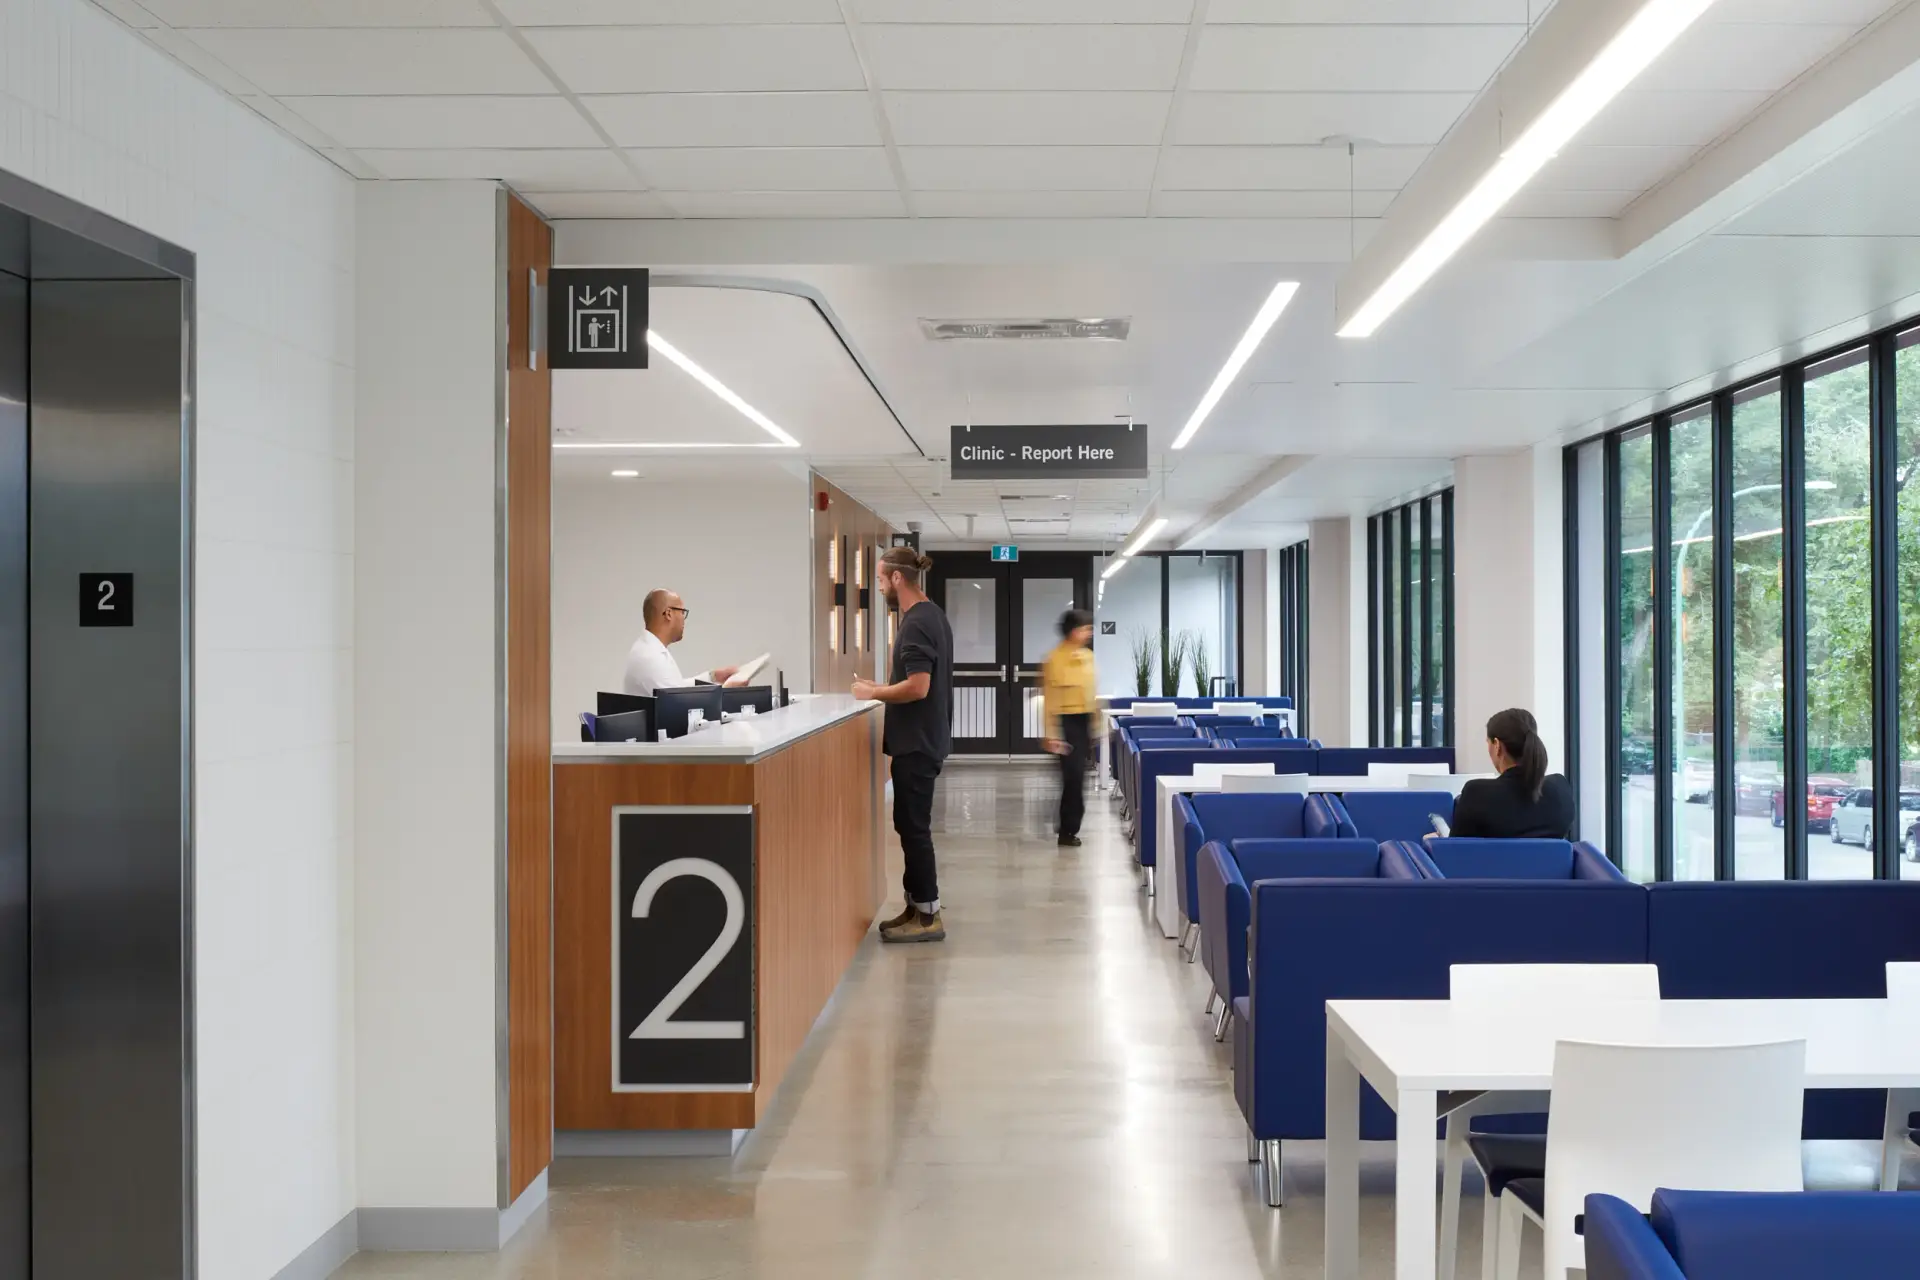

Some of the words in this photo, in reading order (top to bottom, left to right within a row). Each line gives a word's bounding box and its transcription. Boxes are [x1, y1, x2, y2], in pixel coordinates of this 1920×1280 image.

[960, 445, 1005, 461] Clinic
[1021, 445, 1073, 463] Report
[1078, 445, 1115, 460] Here
[97, 580, 115, 610] 2
[628, 857, 745, 1039] 2
